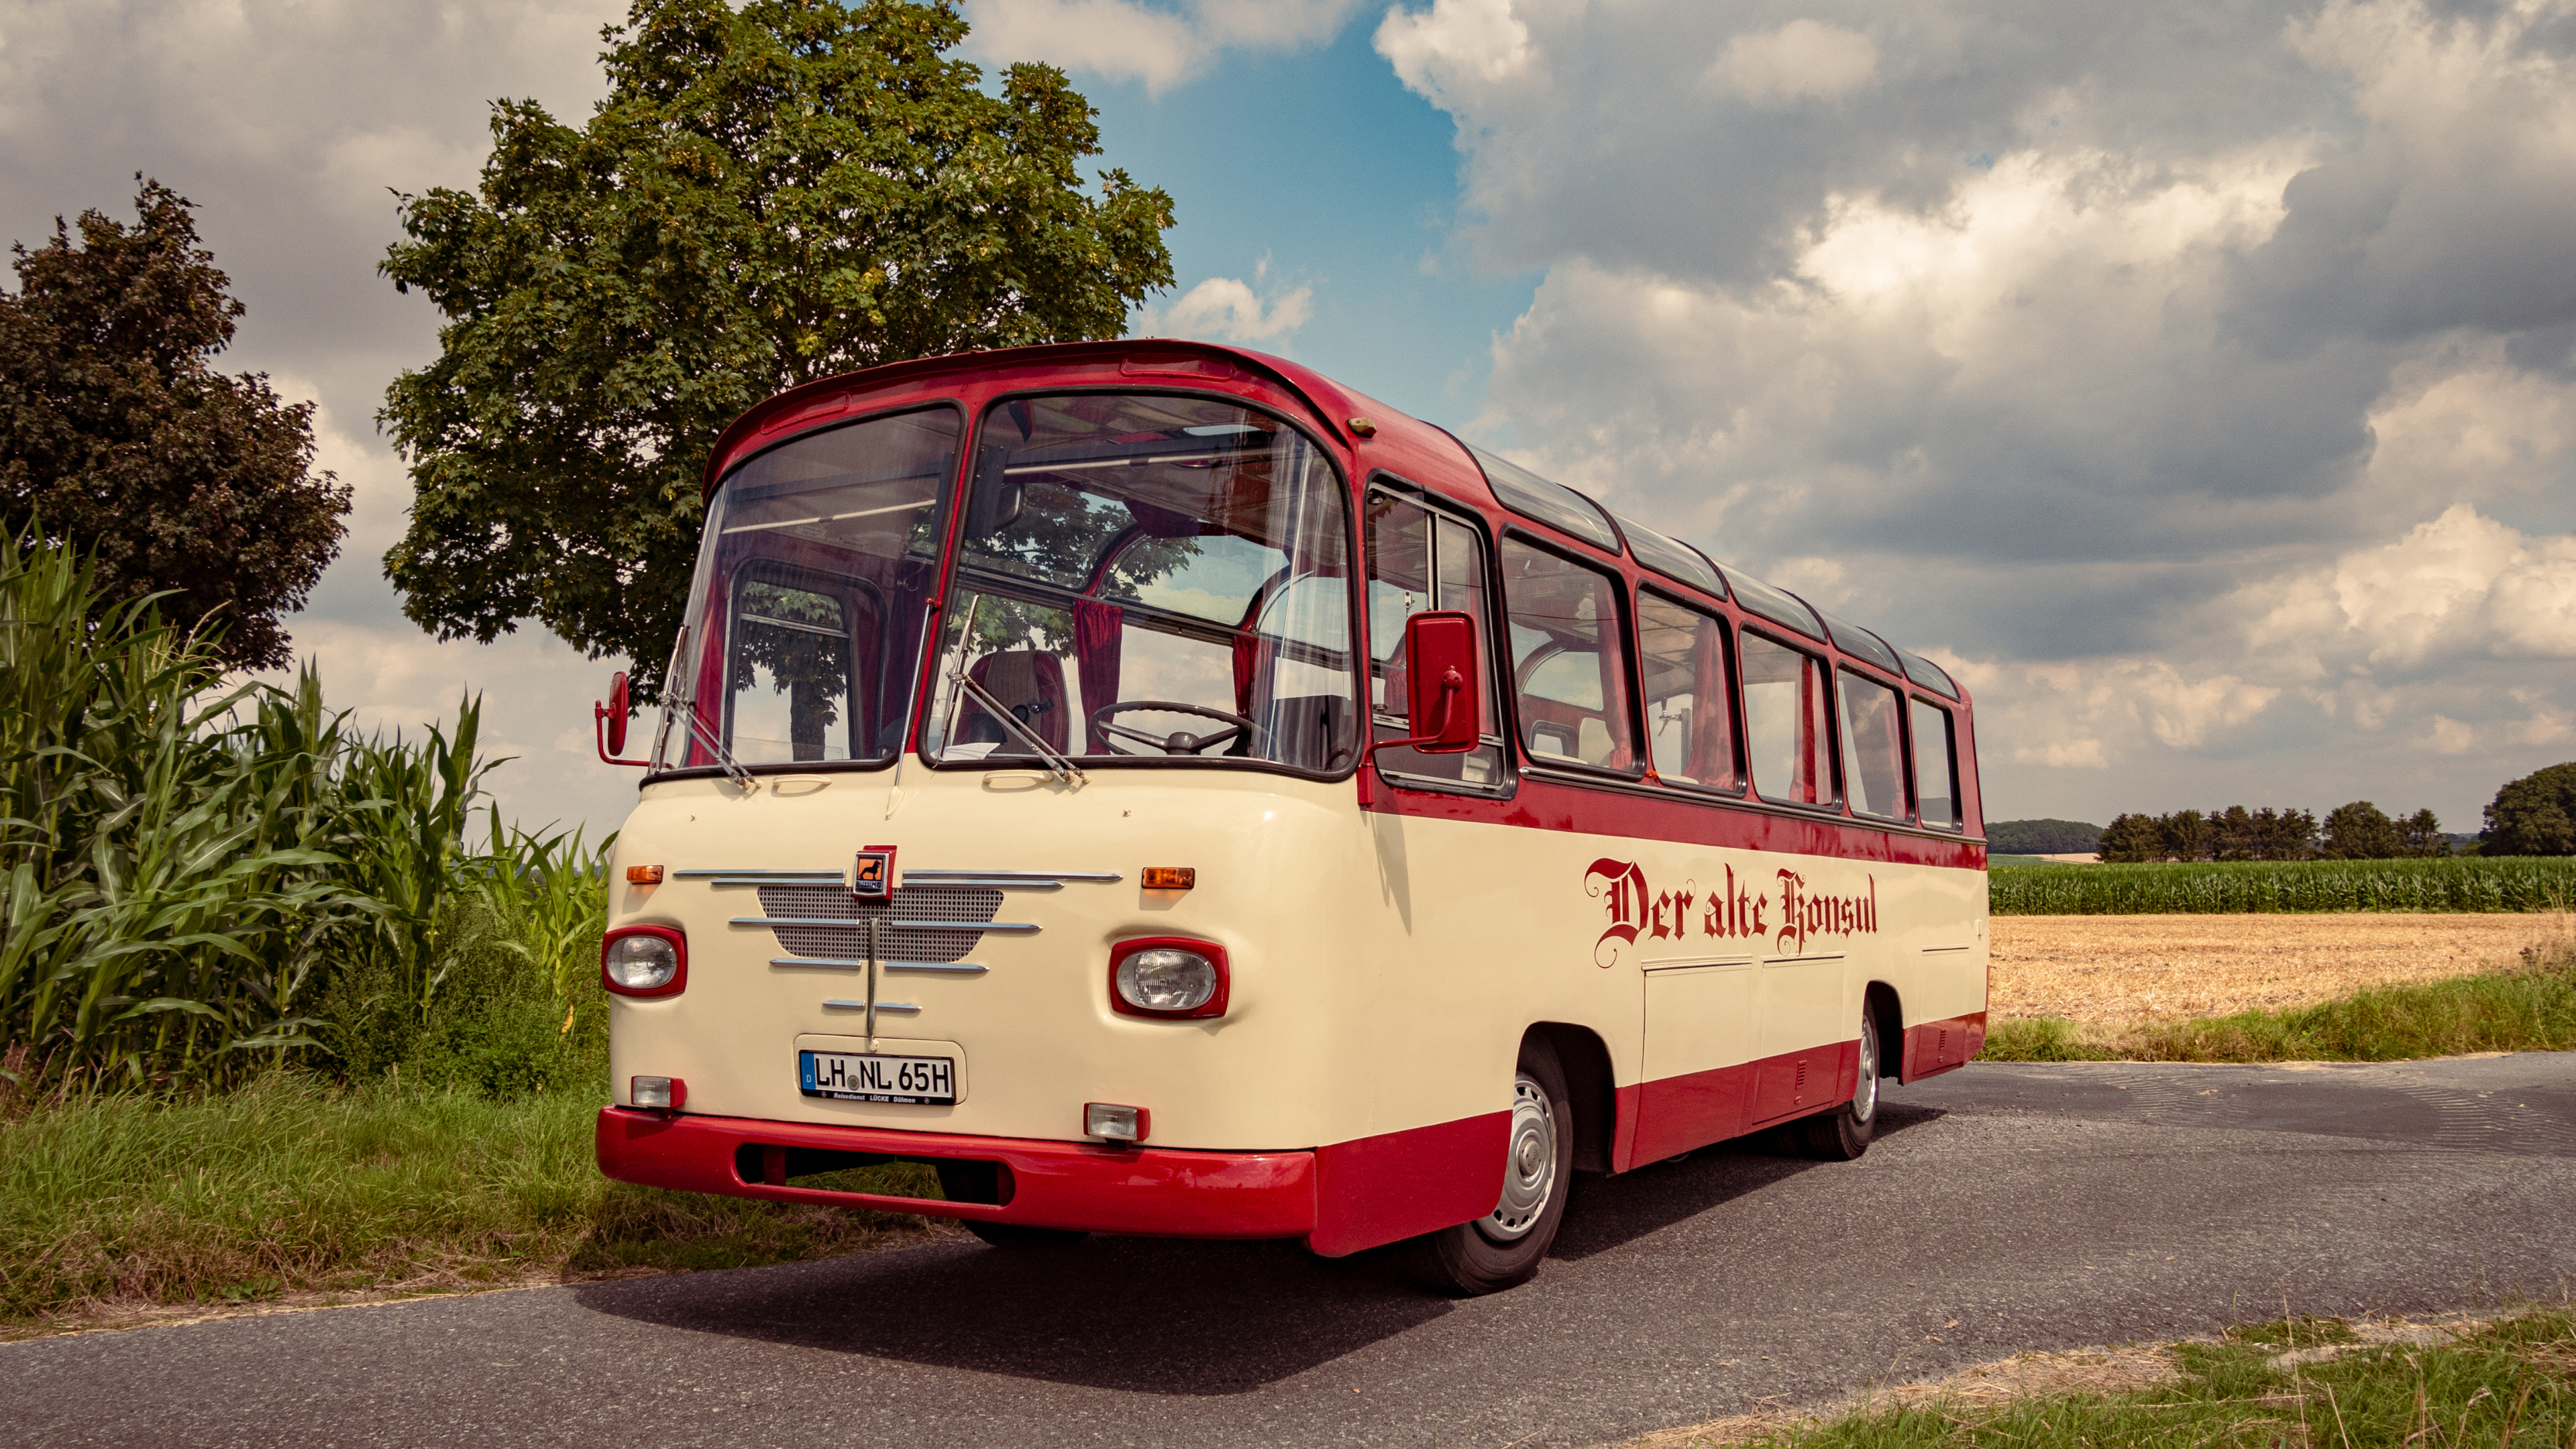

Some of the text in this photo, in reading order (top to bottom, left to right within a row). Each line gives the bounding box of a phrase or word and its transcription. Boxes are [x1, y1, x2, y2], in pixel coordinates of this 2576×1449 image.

[1584, 857, 1878, 968] Der alte Konsul
[806, 1075, 812, 1083] D
[816, 1058, 949, 1093] LH NL 65H
[834, 1093, 865, 1101] Reisedienst
